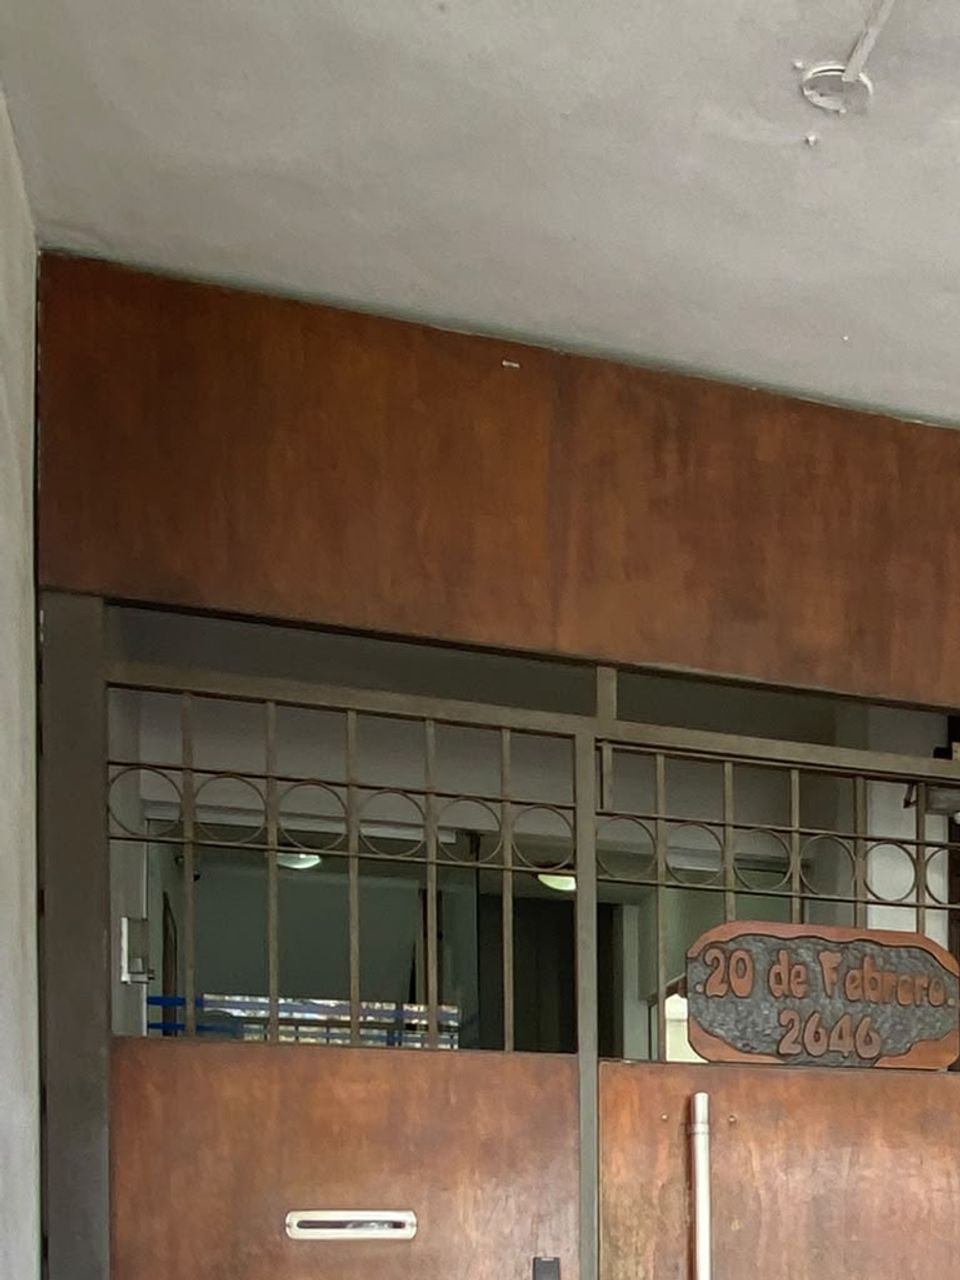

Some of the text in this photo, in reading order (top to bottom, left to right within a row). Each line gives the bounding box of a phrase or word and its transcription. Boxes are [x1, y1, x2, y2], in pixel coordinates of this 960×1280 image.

[703, 949, 946, 1007] 20 de Febrero
[777, 1009, 881, 1059] 2646
